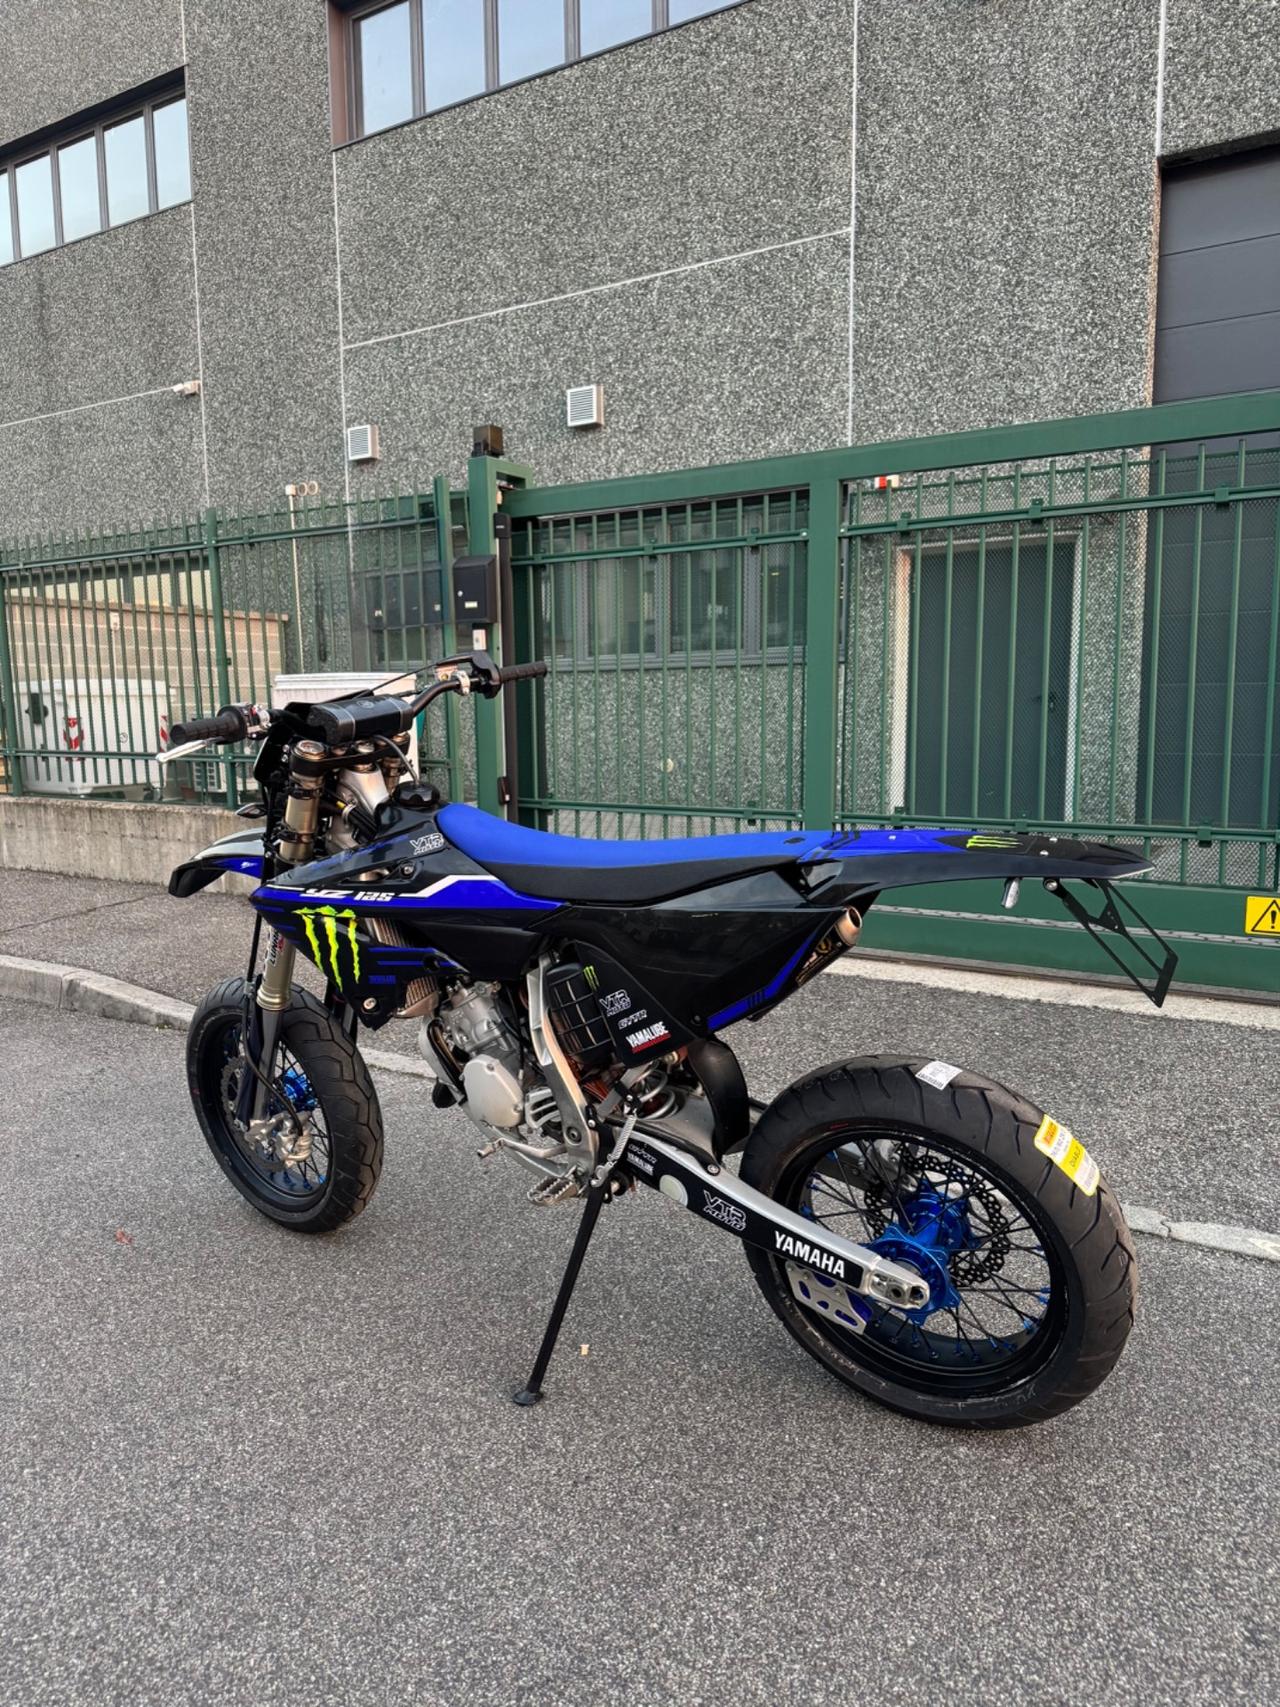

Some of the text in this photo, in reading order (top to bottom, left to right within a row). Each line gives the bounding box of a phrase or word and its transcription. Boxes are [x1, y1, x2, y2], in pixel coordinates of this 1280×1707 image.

[354, 891, 395, 902] 125
[599, 989, 631, 1009] VTR
[625, 1021, 669, 1048] YAMALUBE
[704, 1190, 747, 1224] VTR
[704, 1206, 746, 1231] MOTO
[774, 1230, 845, 1279] YAMAHA
